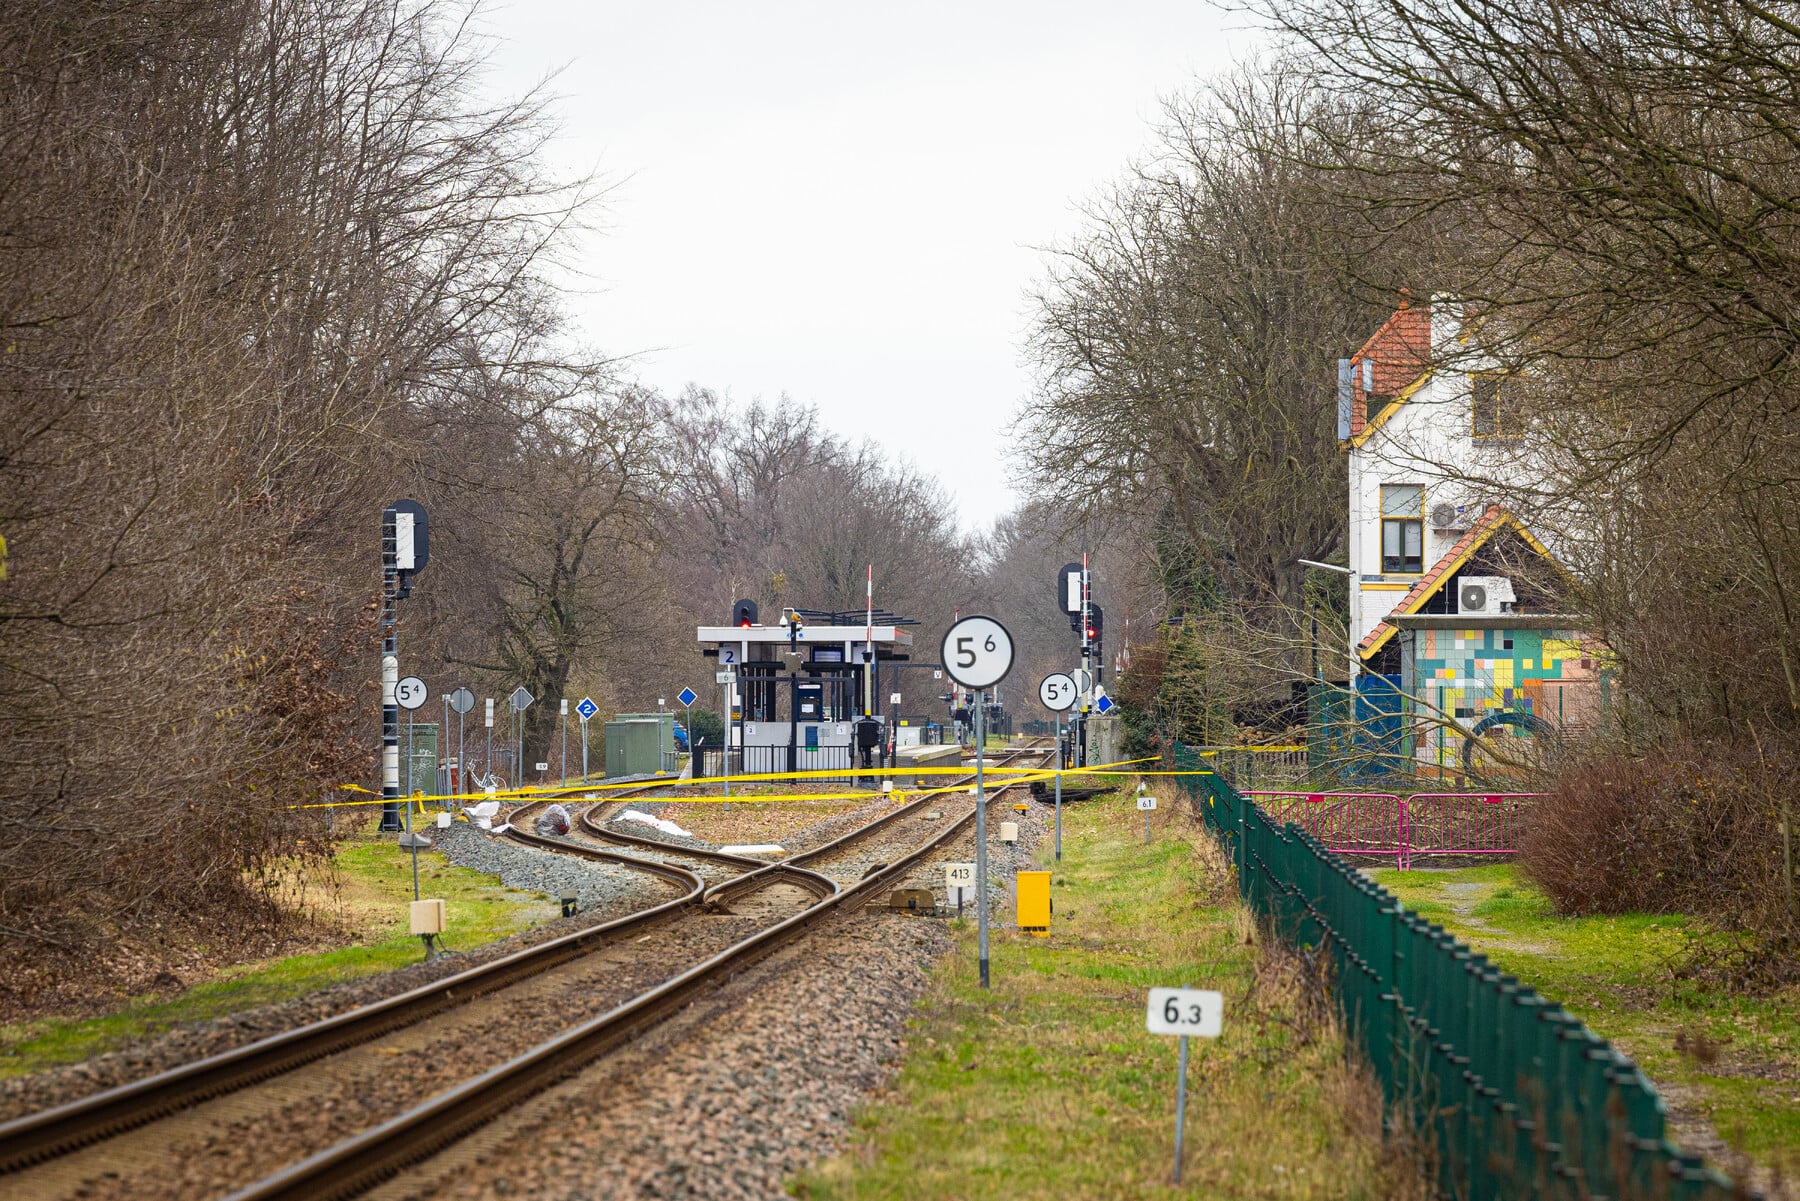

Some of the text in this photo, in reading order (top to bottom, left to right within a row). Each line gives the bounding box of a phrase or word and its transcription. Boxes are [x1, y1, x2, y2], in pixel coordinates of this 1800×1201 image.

[726, 651, 734, 663] 2
[724, 674, 729, 682] 6
[583, 704, 592, 713] 2
[951, 868, 970, 879] 413
[1164, 996, 1202, 1025] 6.3
